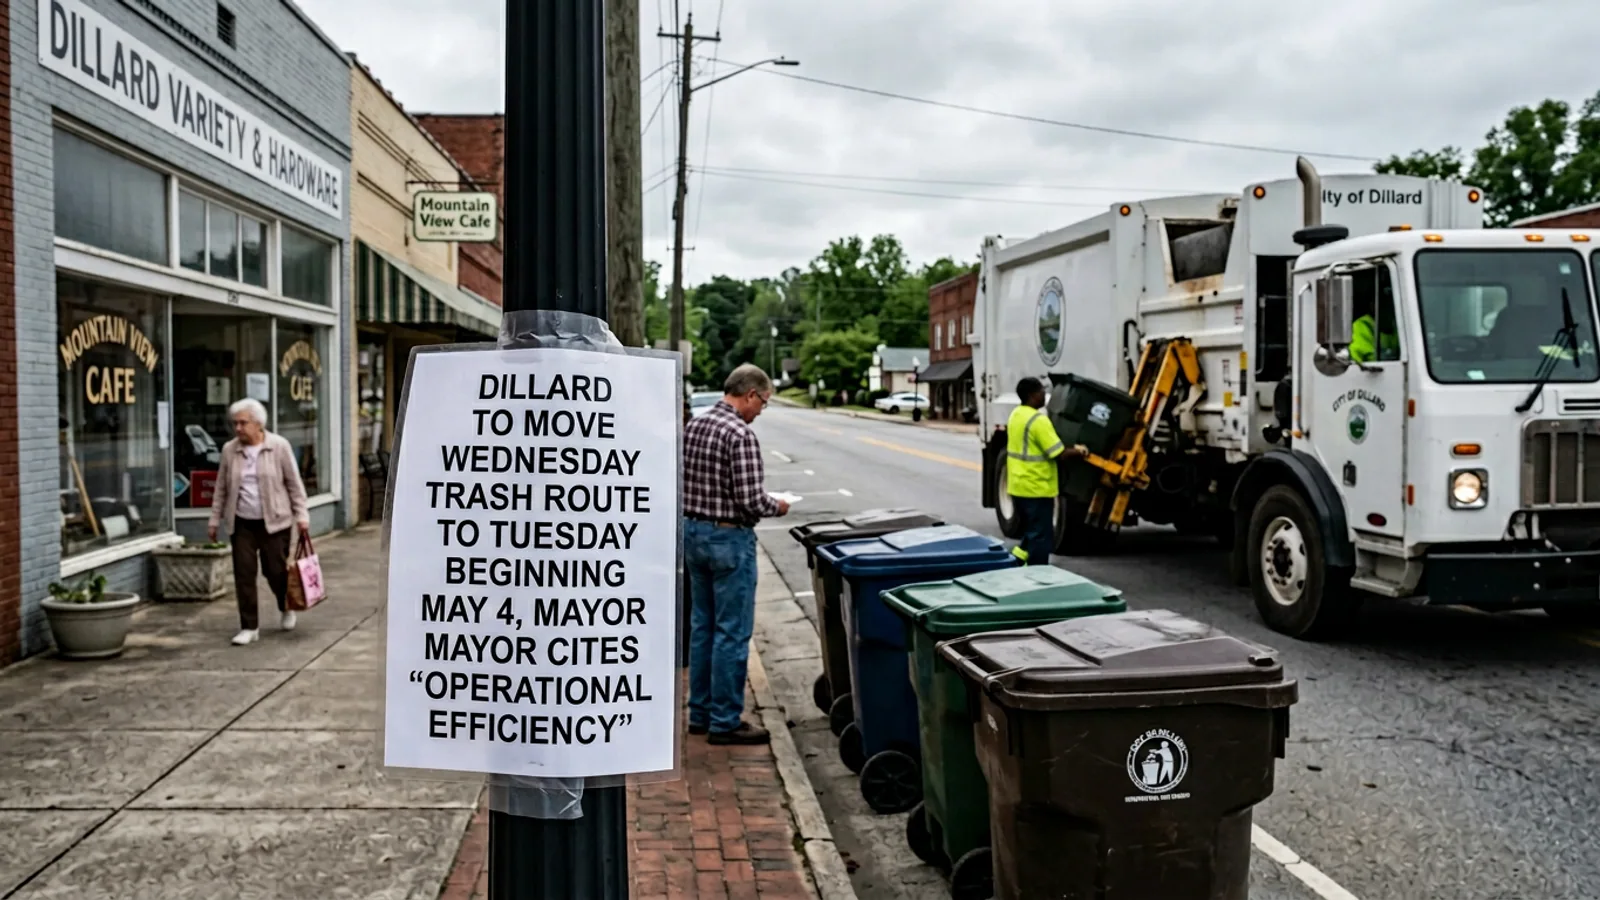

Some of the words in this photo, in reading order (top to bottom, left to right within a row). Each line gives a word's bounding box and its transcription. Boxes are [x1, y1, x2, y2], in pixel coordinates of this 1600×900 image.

[50, 1, 160, 111] DILLARD
[168, 72, 246, 160] VARIETY
[253, 126, 263, 170] &
[269, 136, 339, 210] HARDWARE
[420, 197, 490, 212] Mountain
[1322, 189, 1342, 207] ity
[1347, 189, 1364, 204] of
[1369, 188, 1422, 205] Dillard
[420, 213, 455, 227] View
[459, 214, 491, 228] Cafe
[60, 315, 127, 371] MOUNTAIN
[129, 323, 159, 374] VIEW
[85, 365, 136, 405] CAFE
[478, 373, 612, 402] DILLARD
[472, 409, 514, 436] TO
[523, 410, 615, 439] MOVE
[441, 445, 641, 476] WEDNESDAY
[425, 481, 533, 511] TRASH
[544, 484, 651, 513] ROUTE
[437, 519, 480, 547] TO
[489, 520, 639, 550] TUESDAY
[445, 557, 625, 588] BEGINNING
[421, 594, 489, 624] MAY
[496, 597, 523, 631] 4,
[534, 597, 647, 627] MAYOR
[425, 632, 537, 666] MAYOR
[547, 635, 639, 666] CITES
[409, 670, 653, 706] “OPERATIONAL
[429, 709, 633, 745] EFFICIENCY”
